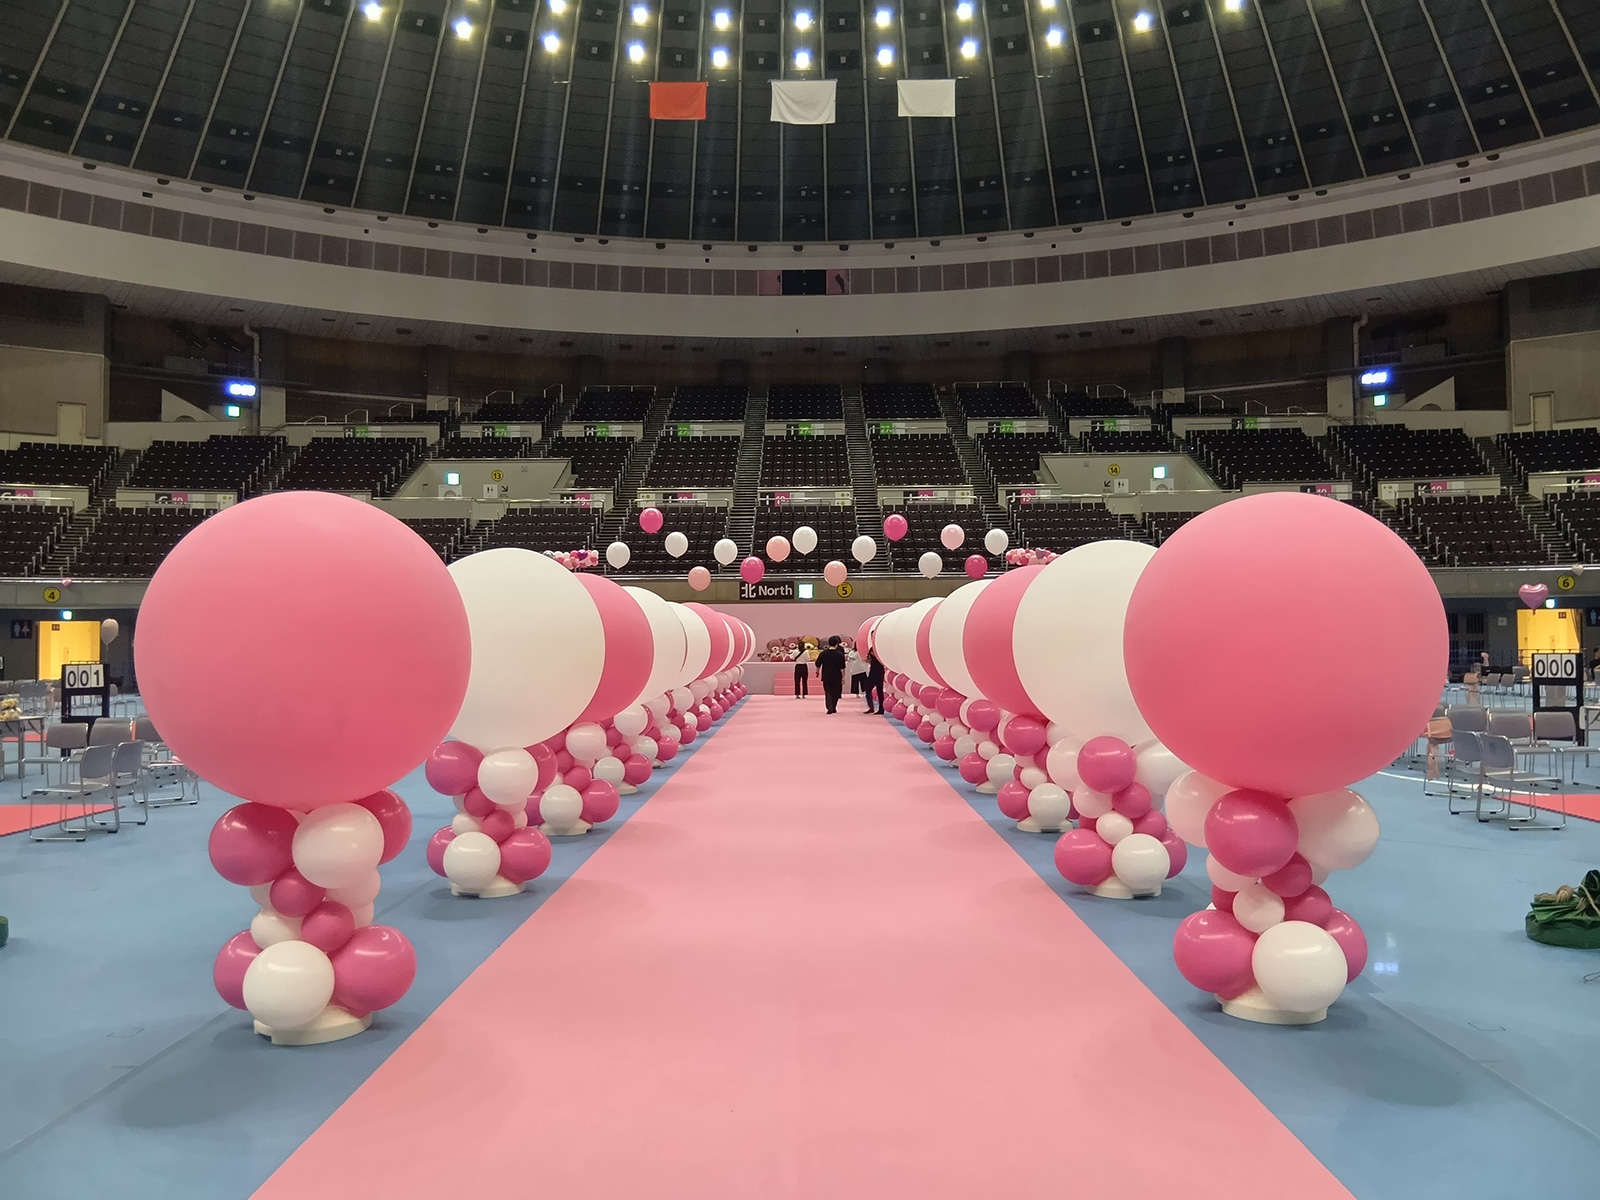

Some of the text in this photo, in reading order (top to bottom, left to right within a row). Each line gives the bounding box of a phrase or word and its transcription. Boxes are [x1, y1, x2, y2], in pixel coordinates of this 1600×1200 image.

[741, 583, 793, 598] 北 North
[1562, 578, 1570, 588] 6
[841, 586, 848, 596] 5
[1535, 659, 1574, 676] 000
[67, 669, 100, 687] 001
